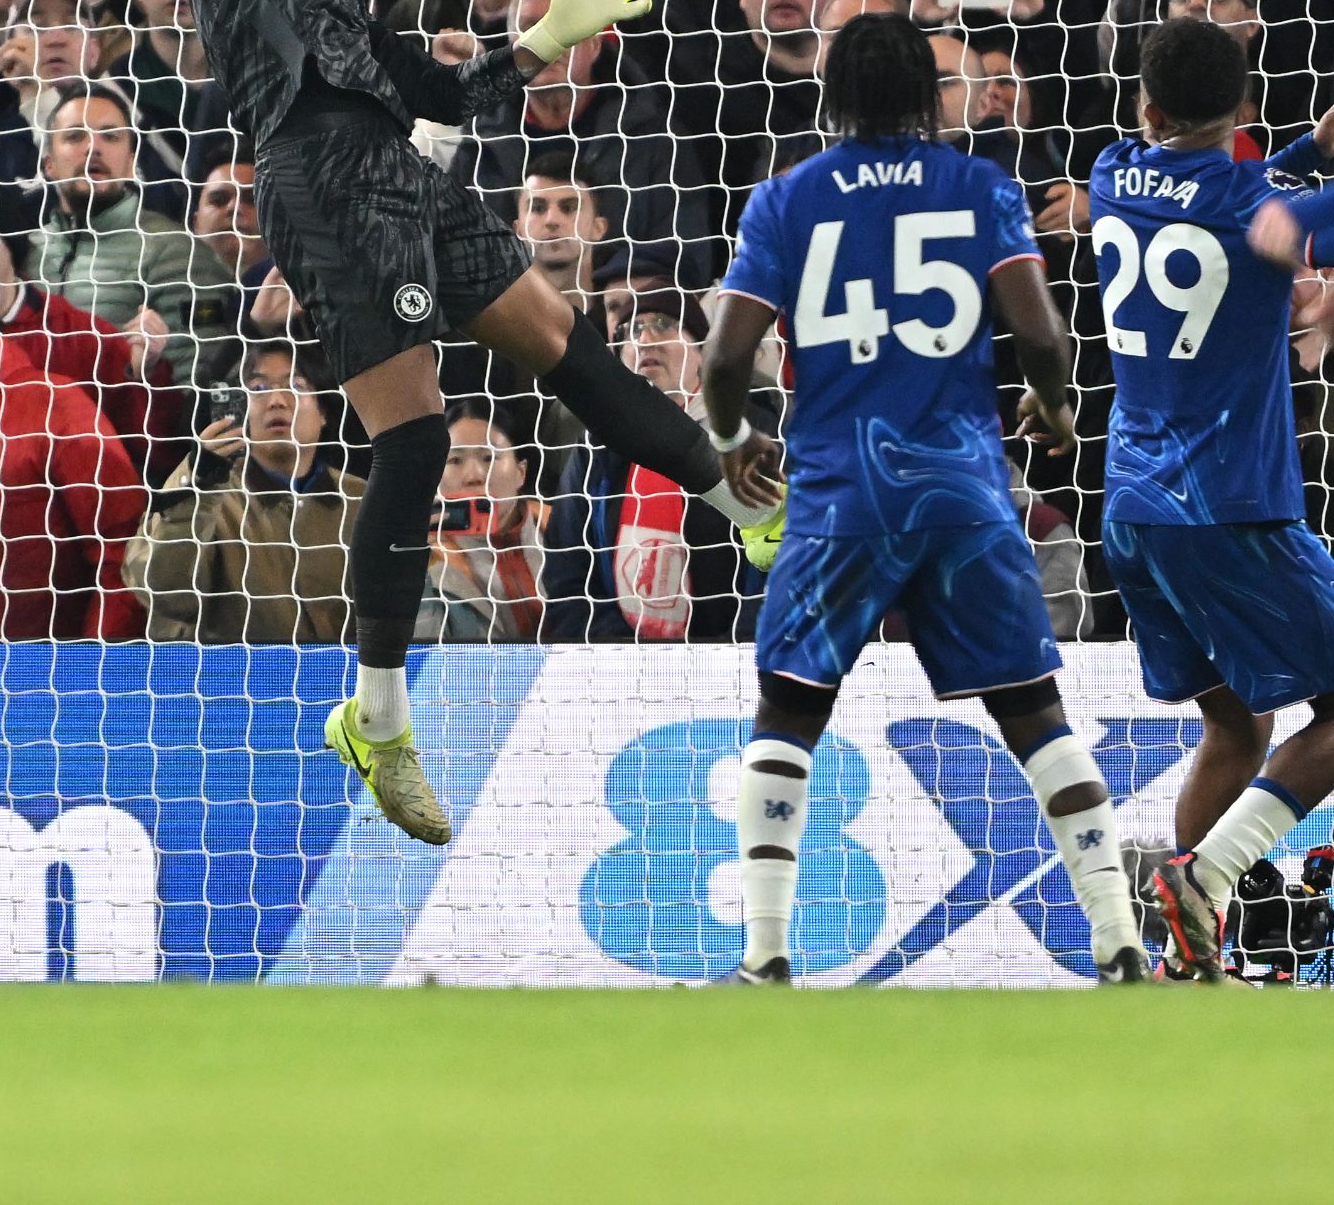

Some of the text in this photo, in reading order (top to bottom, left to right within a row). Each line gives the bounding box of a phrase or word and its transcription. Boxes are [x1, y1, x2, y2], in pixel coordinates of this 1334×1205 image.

[831, 160, 923, 194] LAVIA
[793, 209, 983, 366] 45
[1091, 215, 1230, 361] 29
